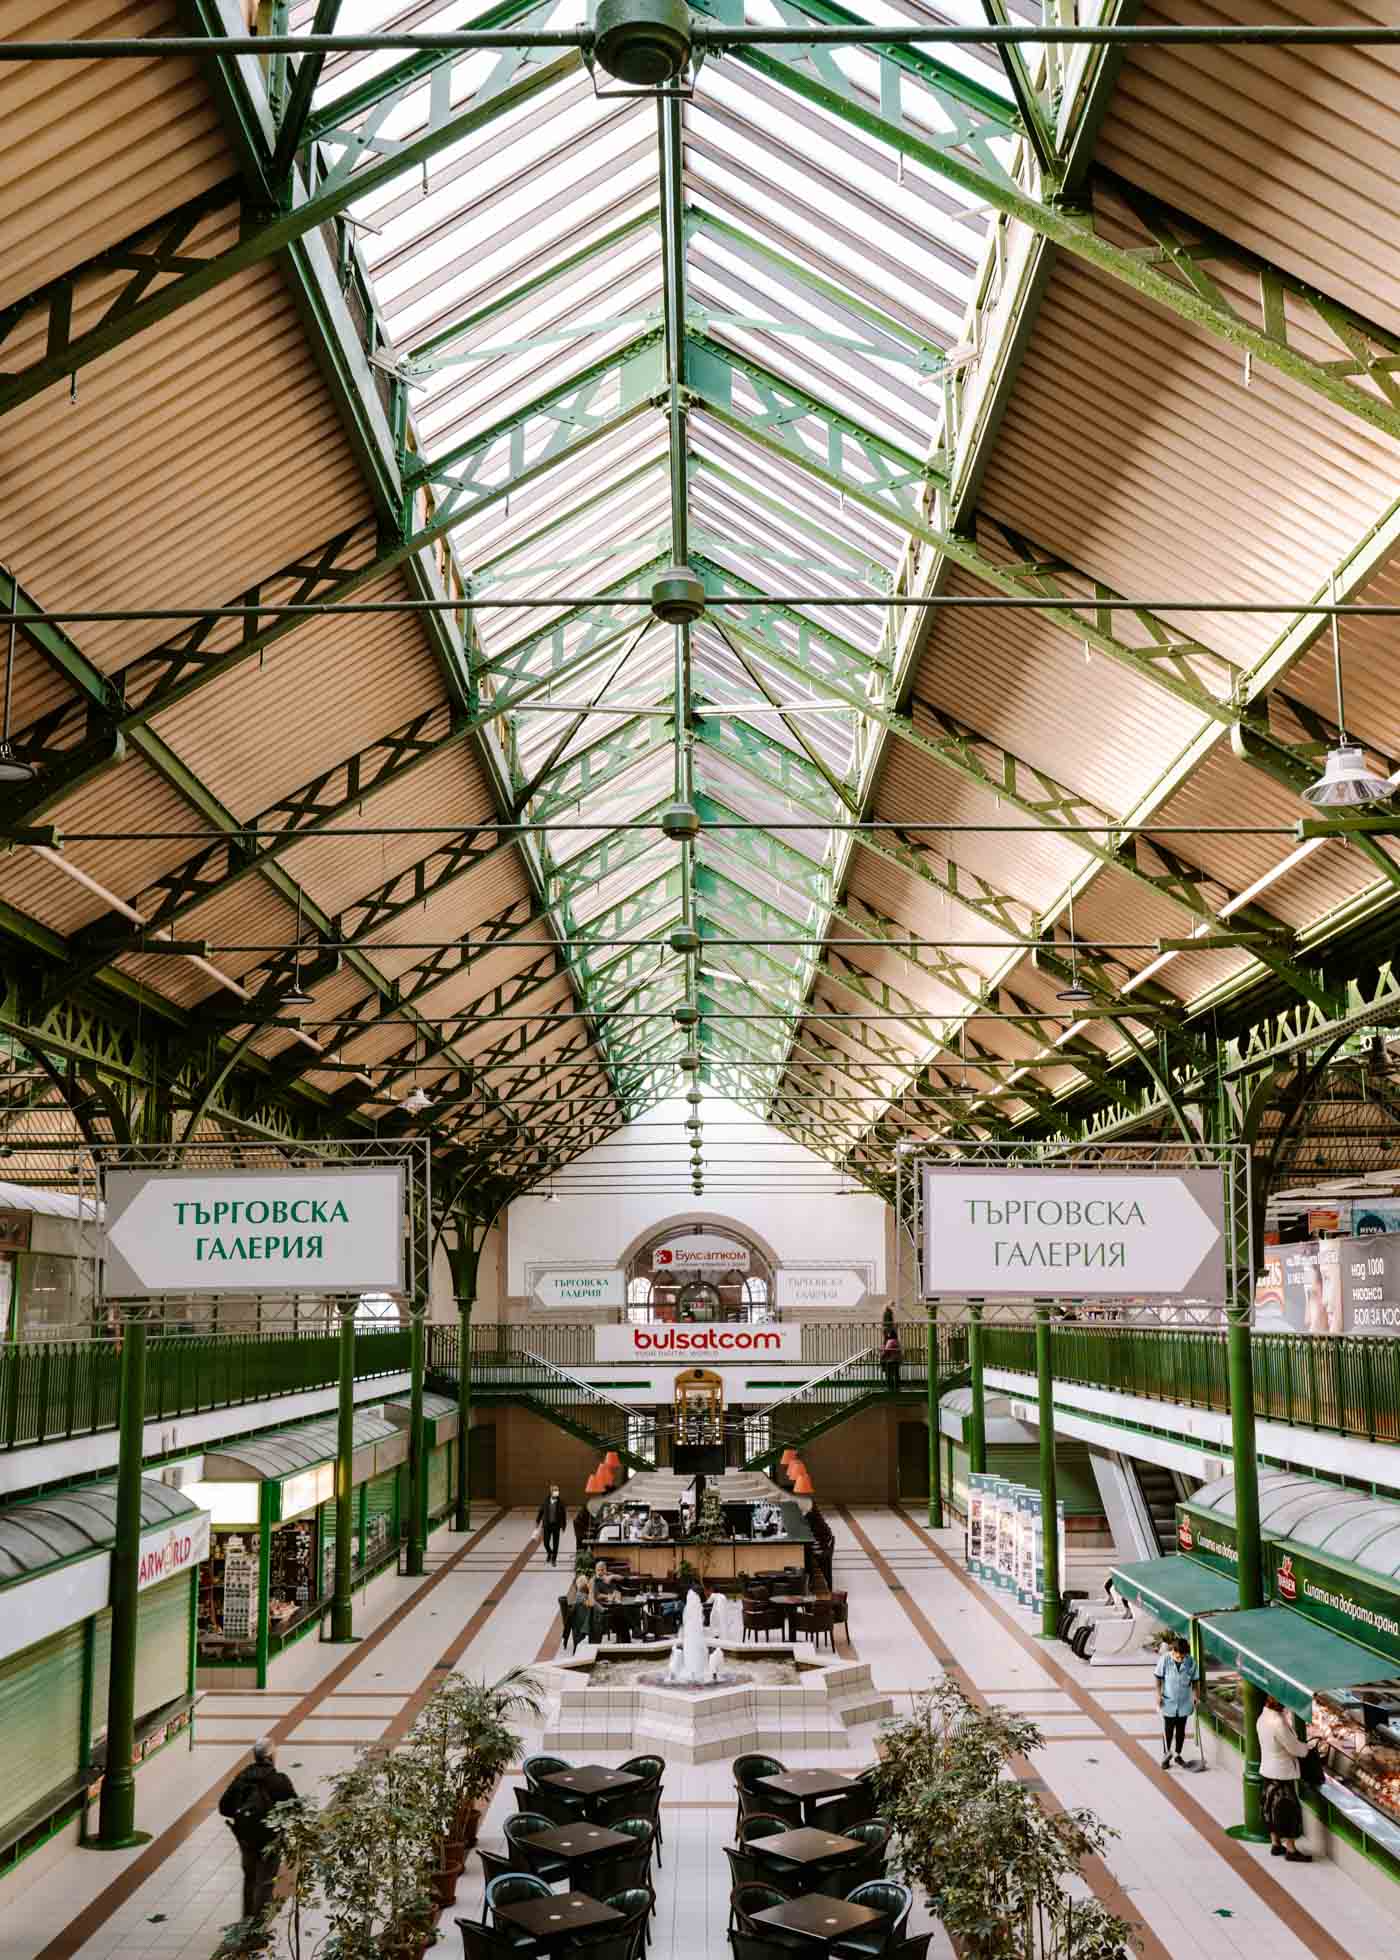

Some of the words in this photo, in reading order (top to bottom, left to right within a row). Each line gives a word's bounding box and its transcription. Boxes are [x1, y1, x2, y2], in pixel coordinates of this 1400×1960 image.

[173, 1200, 349, 1225] ТЪРГОВСКА
[964, 1200, 1146, 1226] ТЪРГОВСКА
[195, 1236, 323, 1261] ГАЛЕРИЯ
[994, 1241, 1125, 1267] ГАЛЕРИЯ
[1367, 1257, 1385, 1276] 1000
[634, 1329, 781, 1349] bulsatcom
[1303, 1578, 1330, 1605] Силата
[1329, 1594, 1339, 1608] на
[1339, 1593, 1373, 1624] добрата
[1373, 1613, 1398, 1636] храна
